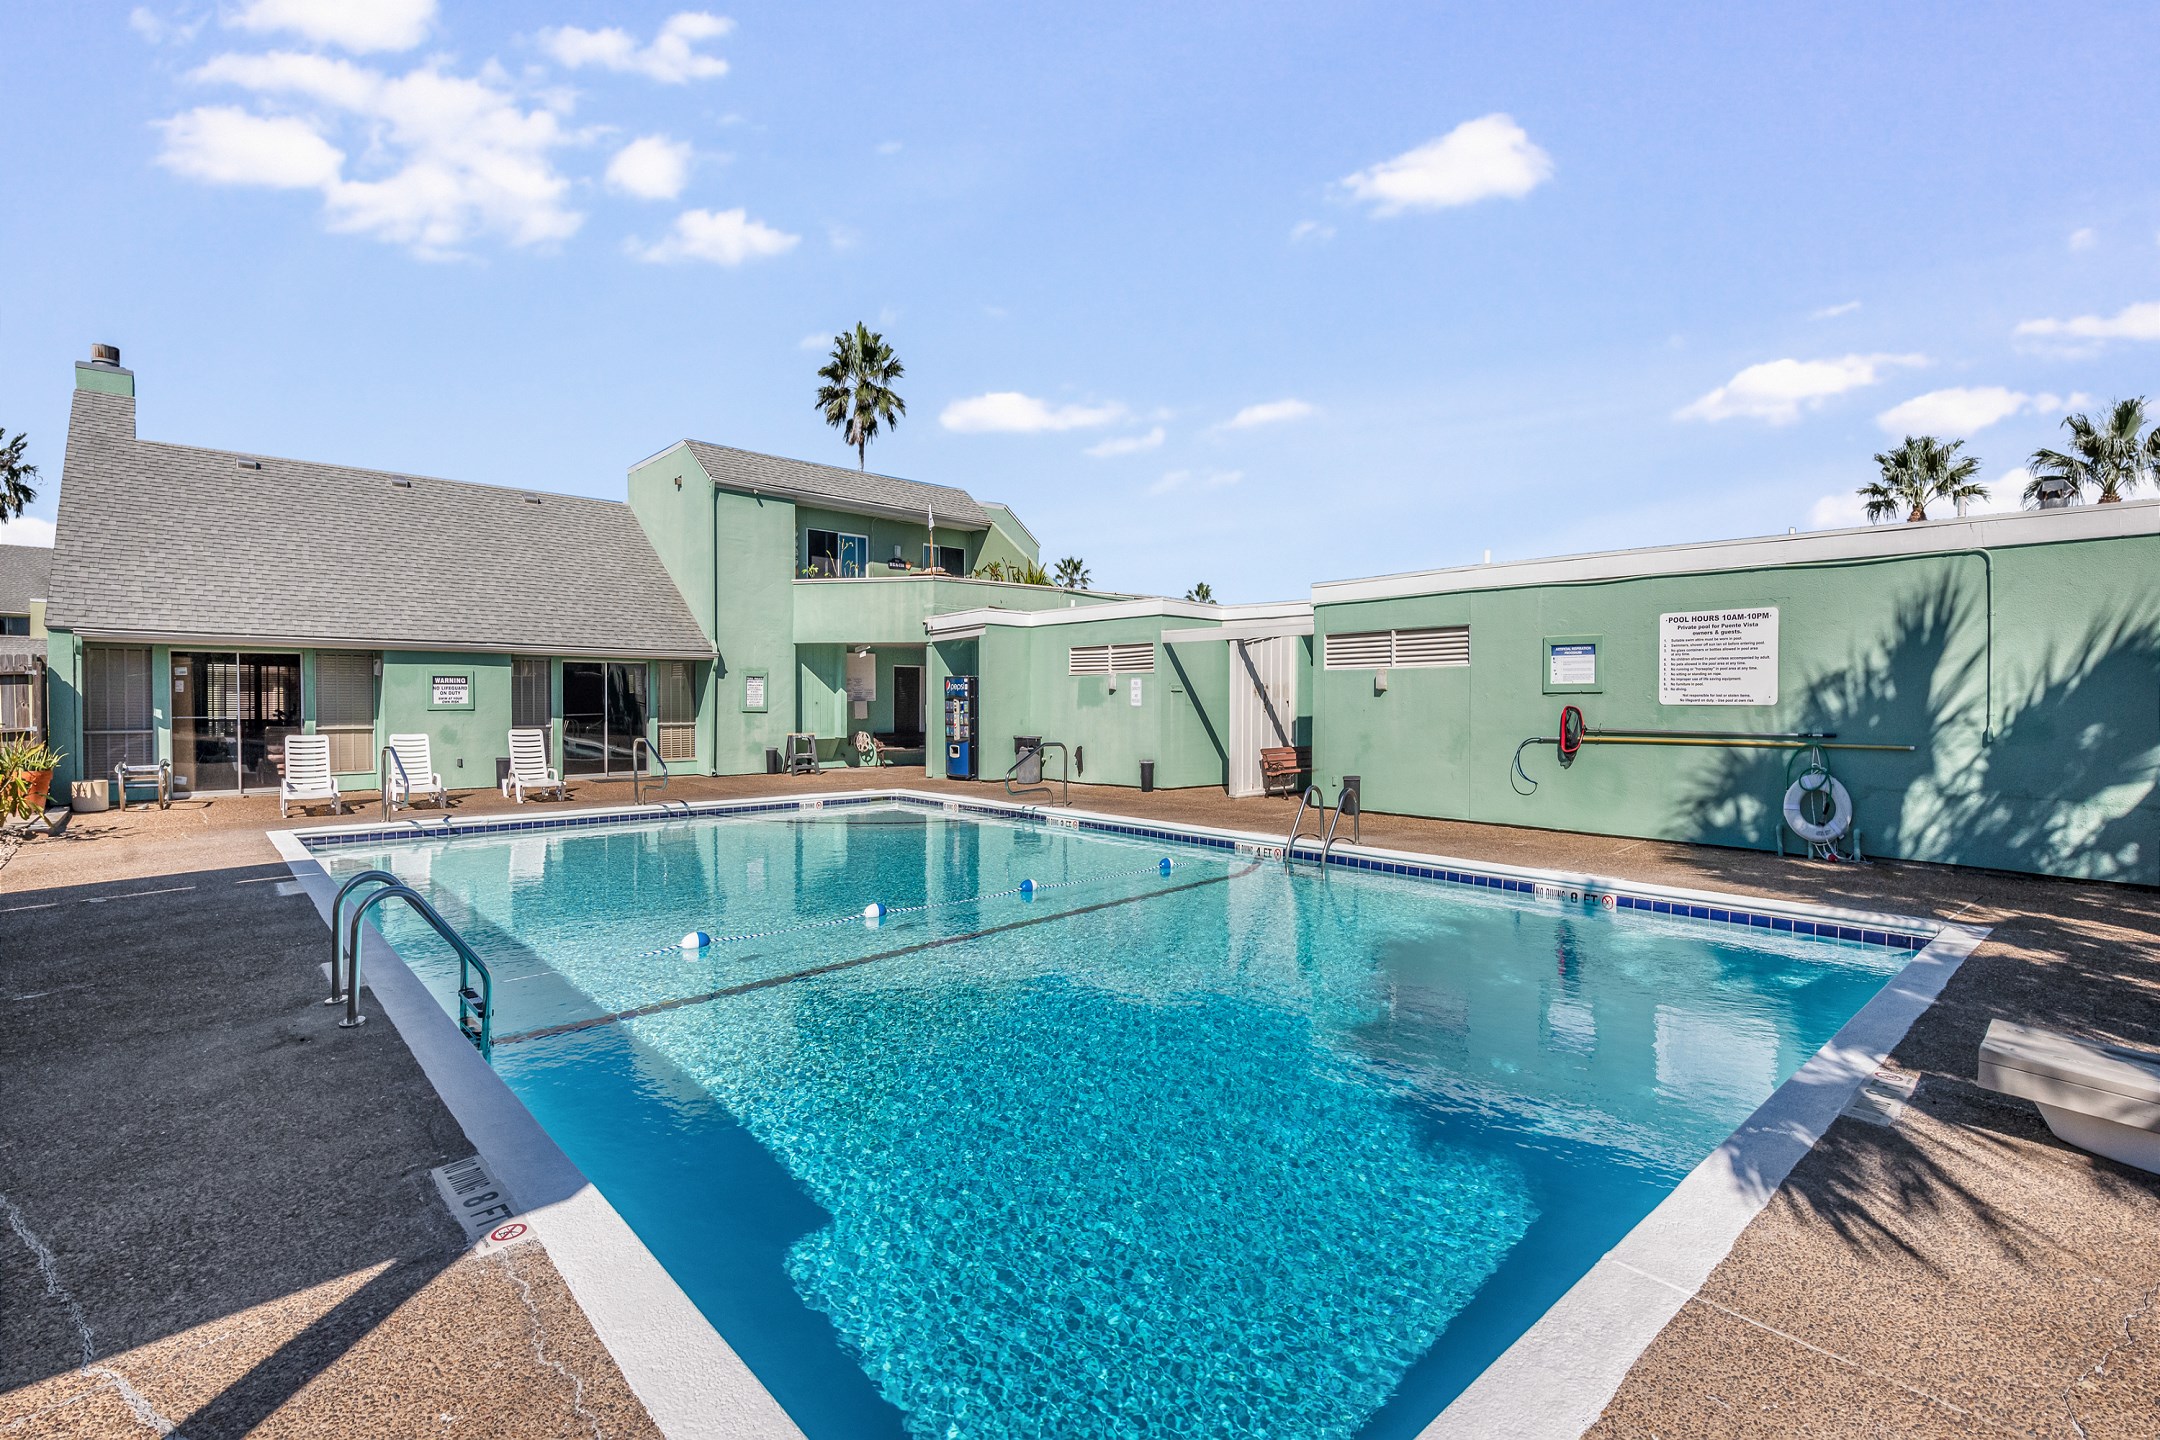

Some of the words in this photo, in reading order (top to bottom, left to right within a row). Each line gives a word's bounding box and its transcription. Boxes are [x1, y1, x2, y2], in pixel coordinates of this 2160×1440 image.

[950, 683, 964, 691] pepsi
[1536, 887, 1543, 898] NO
[1546, 888, 1565, 901] DIVING
[1584, 894, 1598, 906] FT
[442, 1158, 477, 1174] NO
[447, 1167, 490, 1195] DIVING
[463, 1191, 499, 1207] 8
[470, 1203, 514, 1227] FT
